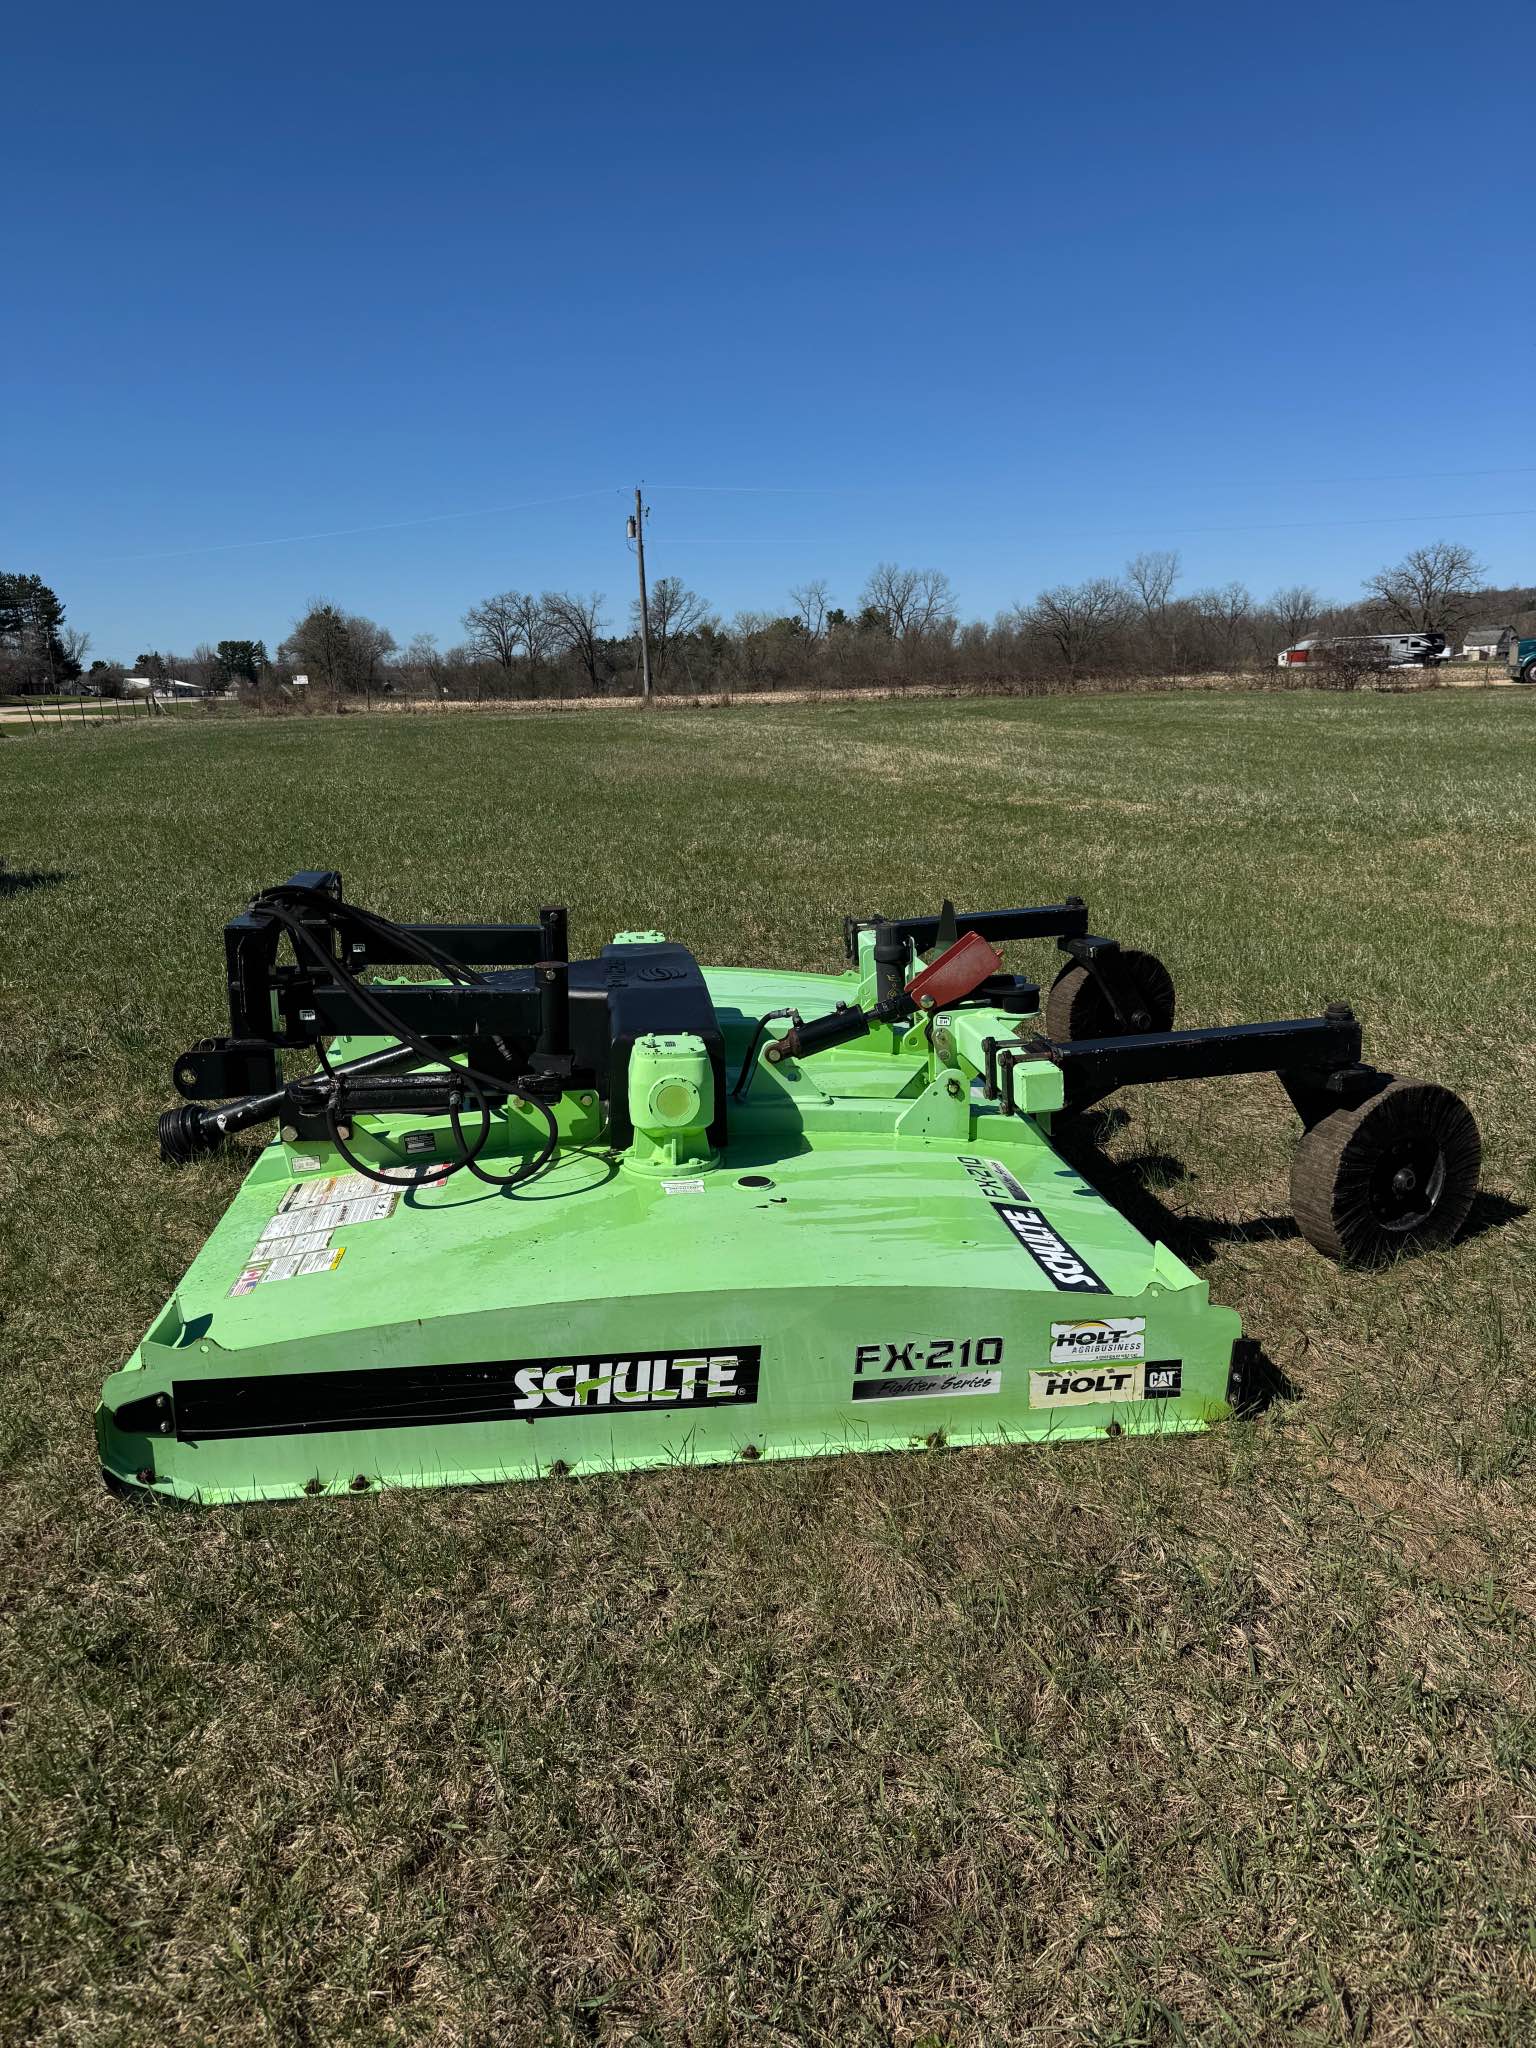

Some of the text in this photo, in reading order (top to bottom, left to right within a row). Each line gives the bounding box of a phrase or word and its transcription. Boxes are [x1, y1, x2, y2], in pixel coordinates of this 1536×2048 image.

[1001, 1209, 1099, 1287] SCHULTE
[1056, 1330, 1127, 1347] HOLT
[1071, 1342, 1141, 1354] AGRIBUSINESS
[853, 1336, 1004, 1375] FX-210
[513, 1355, 739, 1410] SCHULTE
[940, 1376, 992, 1390] Series
[1045, 1373, 1132, 1396] HOLT
[1149, 1370, 1176, 1388] CAT
